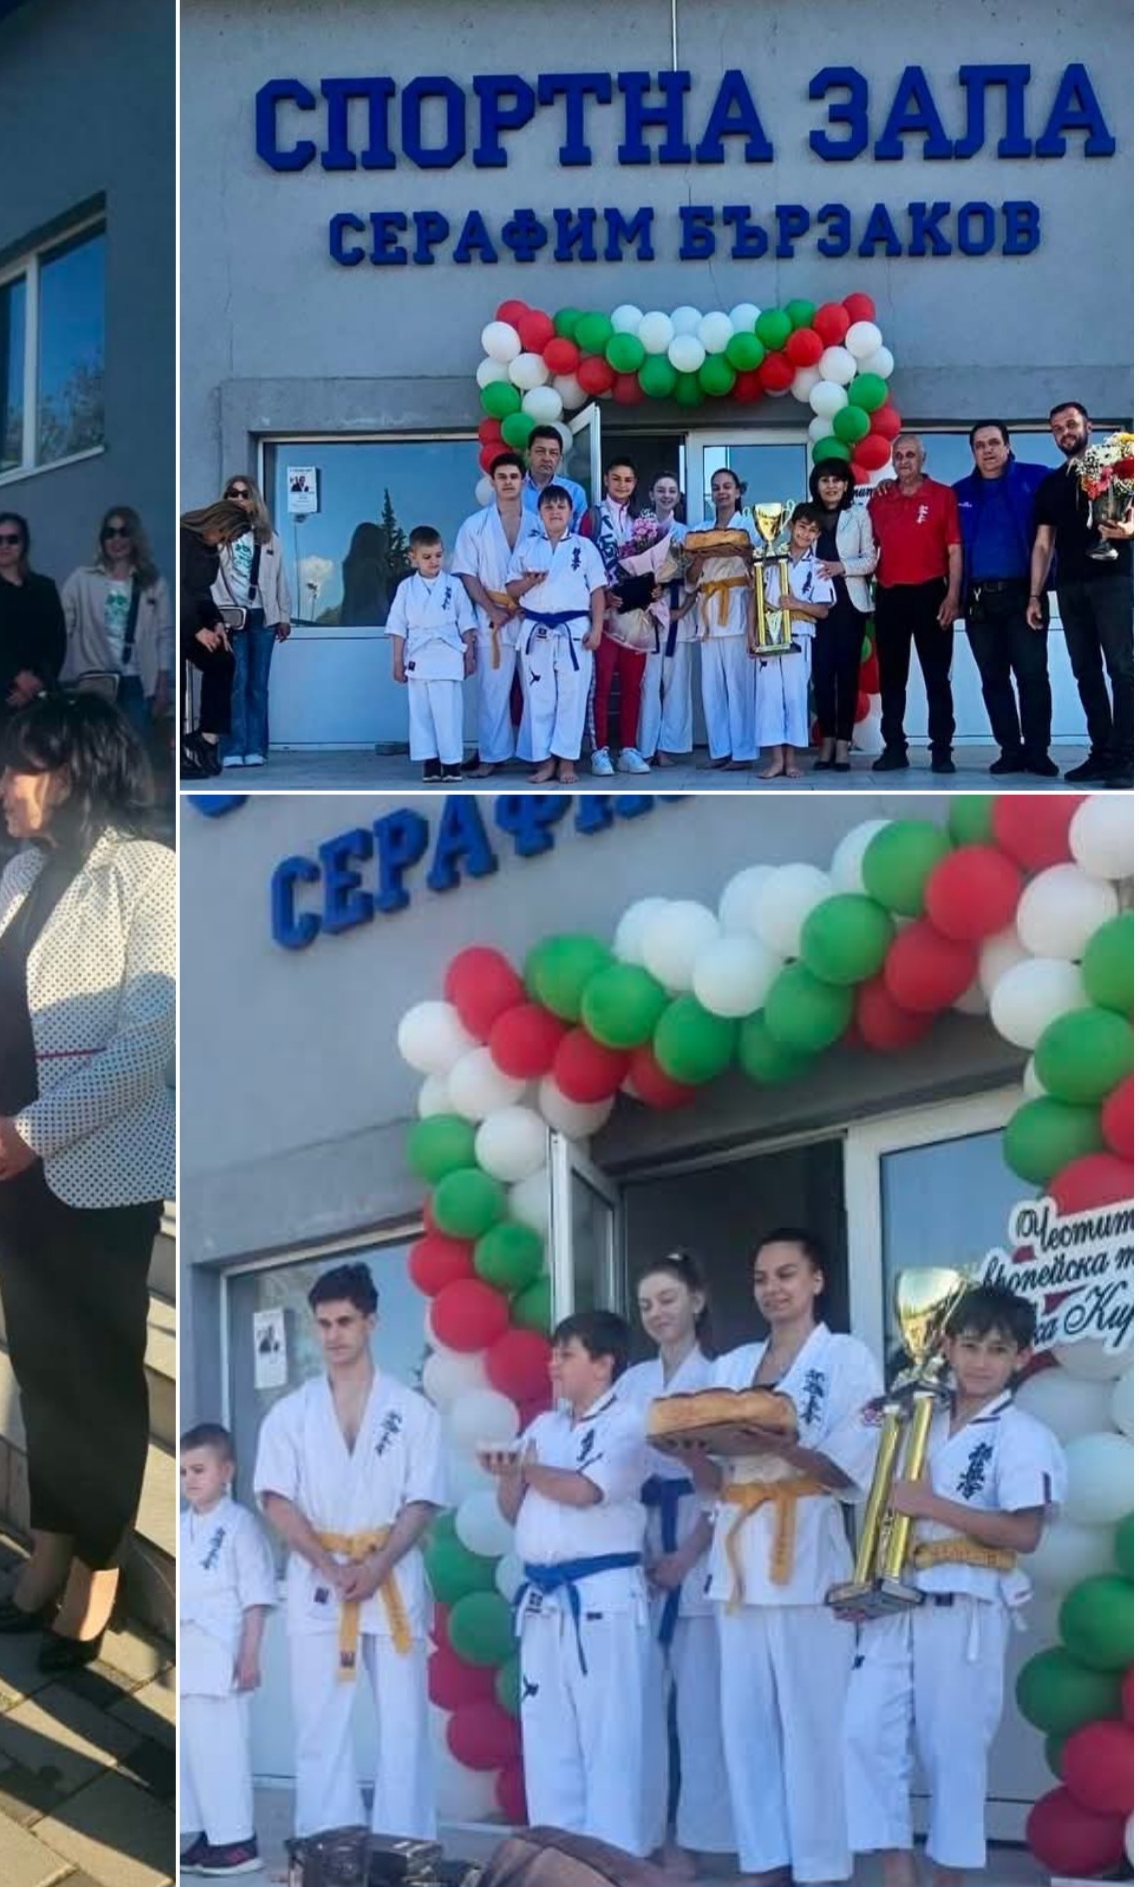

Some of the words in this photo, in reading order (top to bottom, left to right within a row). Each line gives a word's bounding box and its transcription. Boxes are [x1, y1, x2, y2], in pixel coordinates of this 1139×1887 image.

[255, 69, 774, 172] СПОРТНА
[808, 63, 1116, 161] ЗАЛА
[329, 207, 655, 266] СЕРАФИМ
[679, 200, 1041, 260] БЪРЗАКОВ
[271, 795, 696, 950] СЕРАФ
[983, 1254, 1109, 1293] вропейска
